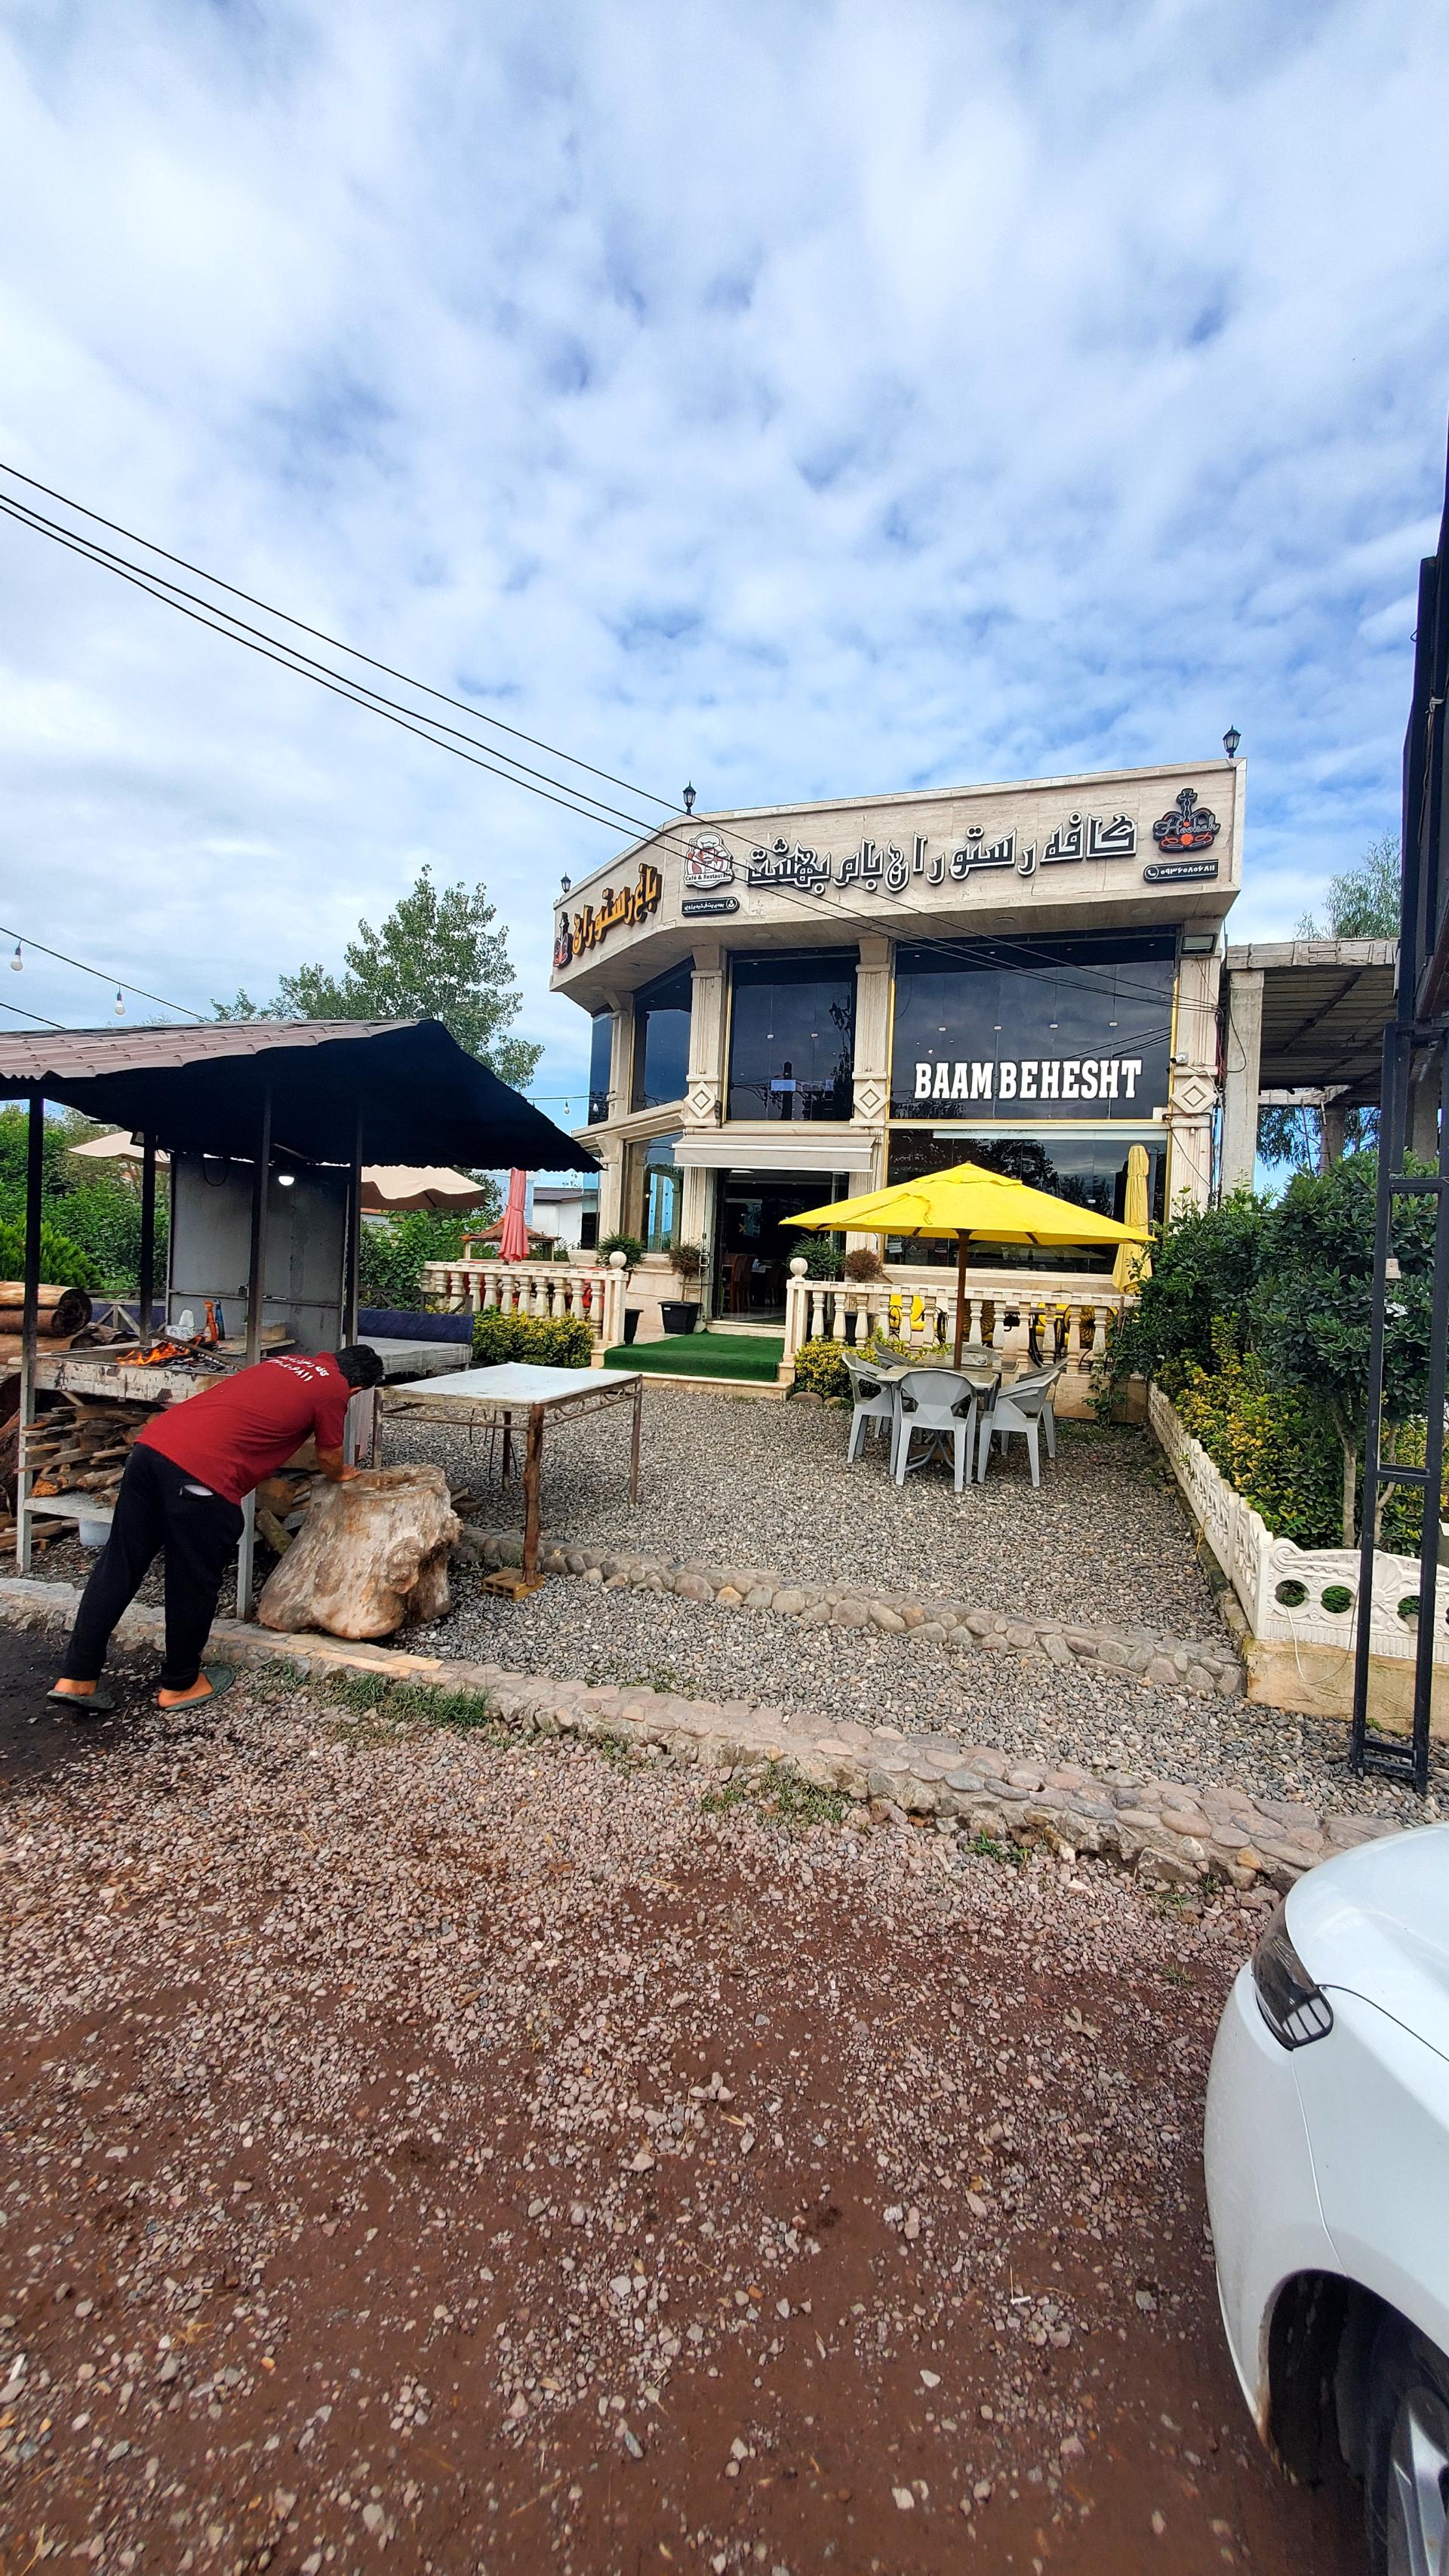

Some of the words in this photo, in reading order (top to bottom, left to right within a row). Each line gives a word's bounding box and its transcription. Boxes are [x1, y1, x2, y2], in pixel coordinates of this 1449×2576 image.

[1040, 811, 1138, 865] کافه
[1154, 814, 1220, 836] Hookah
[745, 836, 831, 895] بهشت
[832, 836, 884, 891] بام
[884, 824, 1038, 894] رستوران
[1160, 864, 1215, 876] ۰۹۳۶۰۸۰۶۸۱۱
[635, 863, 663, 922] باغ
[572, 886, 635, 956] رستوران
[914, 1062, 995, 1100] BAAM
[998, 1059, 1142, 1100] BEHESHT
